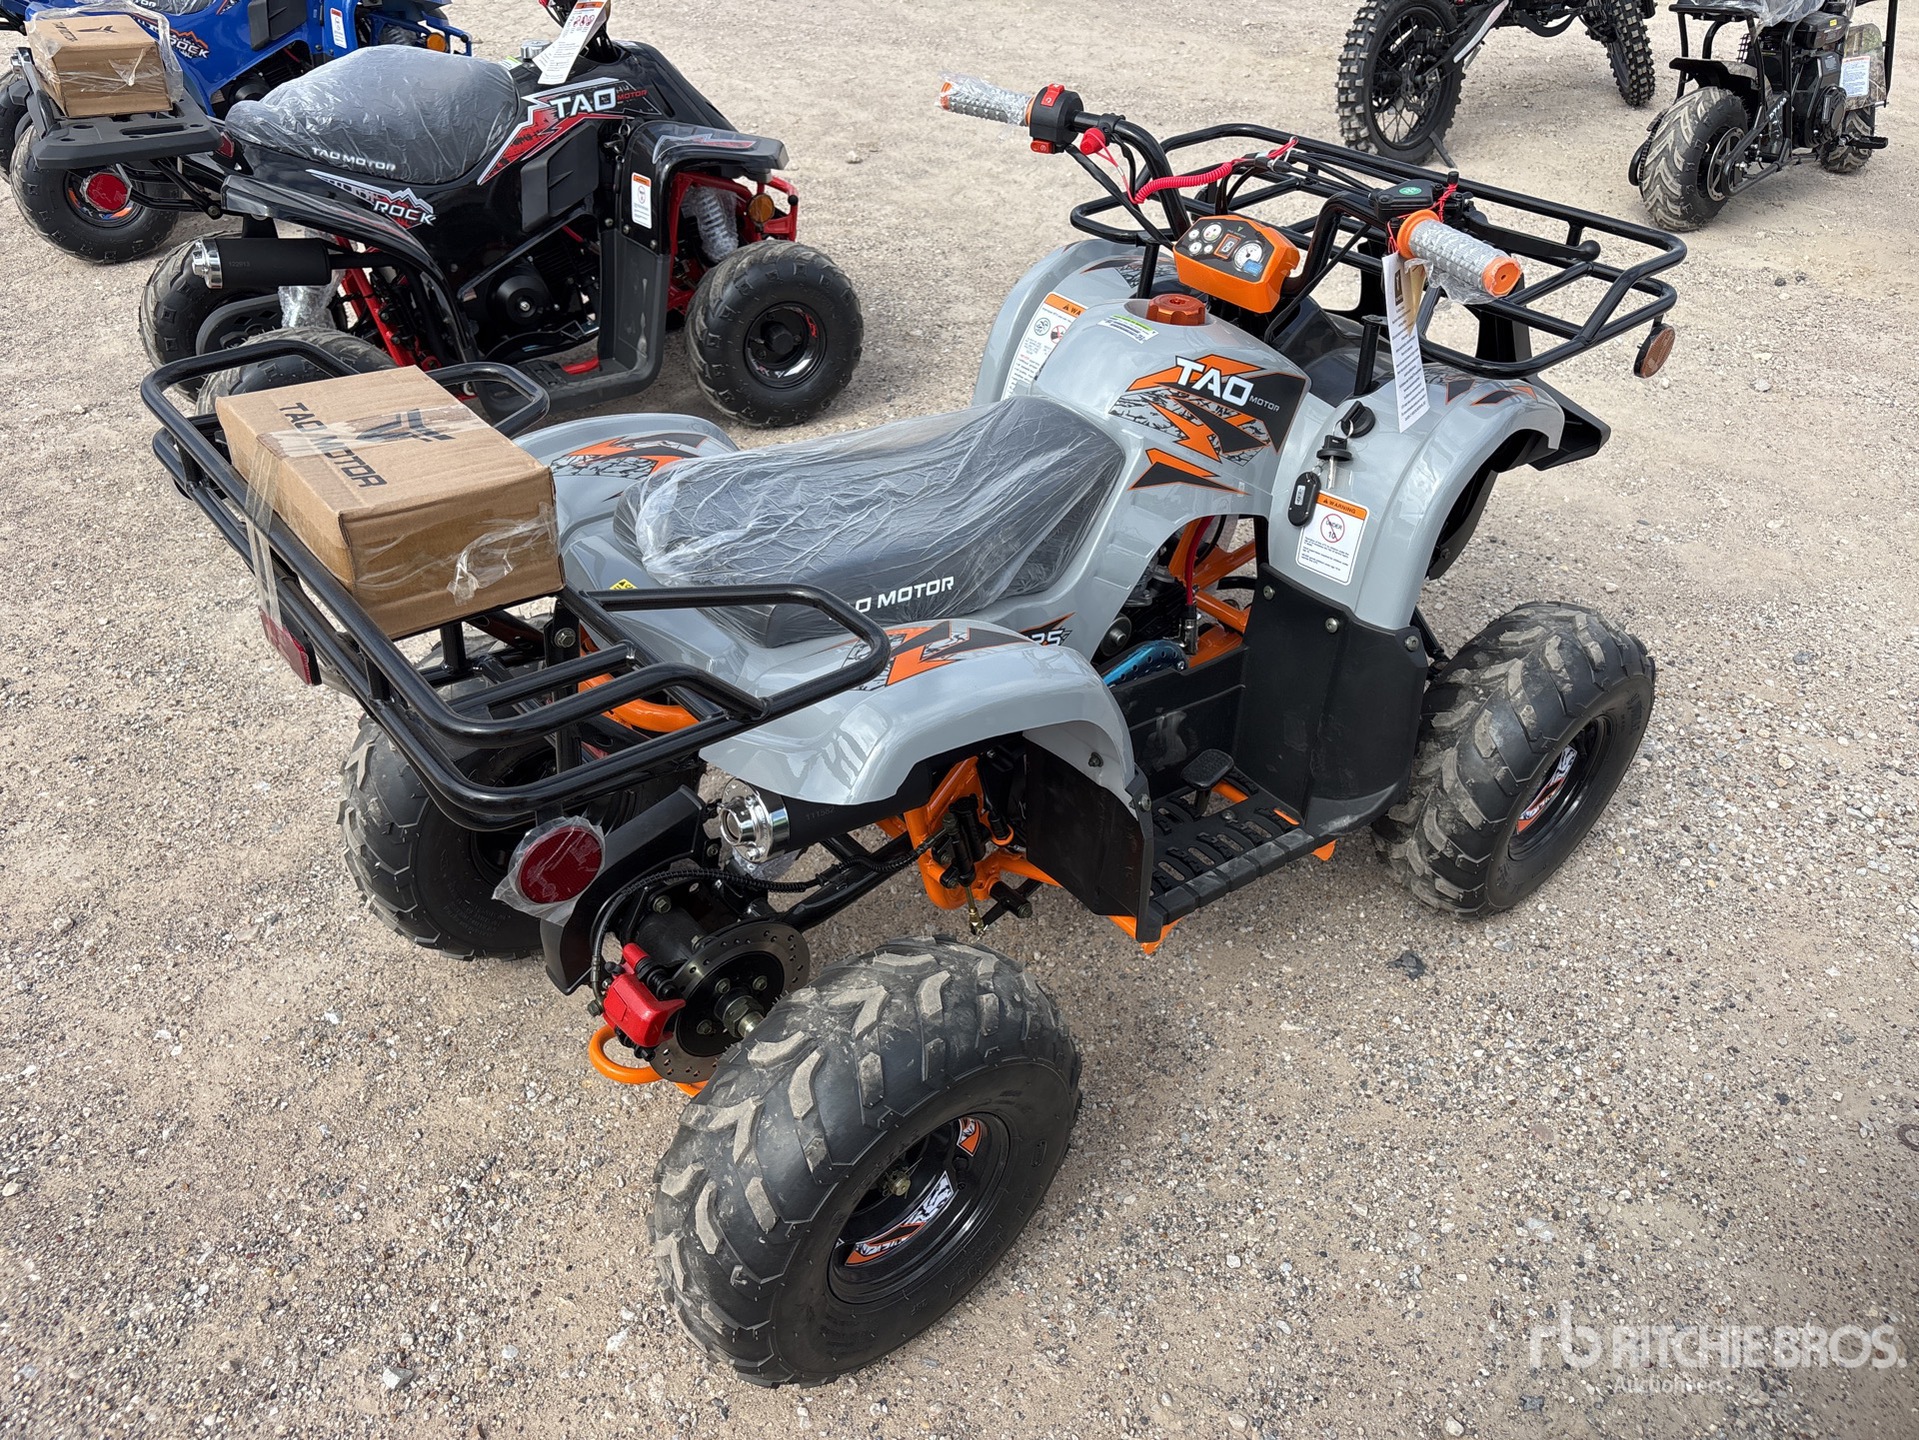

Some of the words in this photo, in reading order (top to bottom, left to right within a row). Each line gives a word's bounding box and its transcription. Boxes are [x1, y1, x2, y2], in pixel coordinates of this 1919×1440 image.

[549, 87, 617, 119] TAO
[616, 89, 648, 100] MOTOR
[311, 147, 341, 160] TAO
[342, 154, 396, 172] MOTOR
[373, 200, 437, 227] ROCK
[1176, 356, 1254, 407] TAO
[1249, 395, 1280, 413] MOTOR
[279, 402, 328, 433] TAO
[1329, 500, 1356, 515] WARNING
[1325, 520, 1343, 531] UNDER
[877, 576, 954, 609] MOTOR
[1027, 629, 1063, 647] 25
